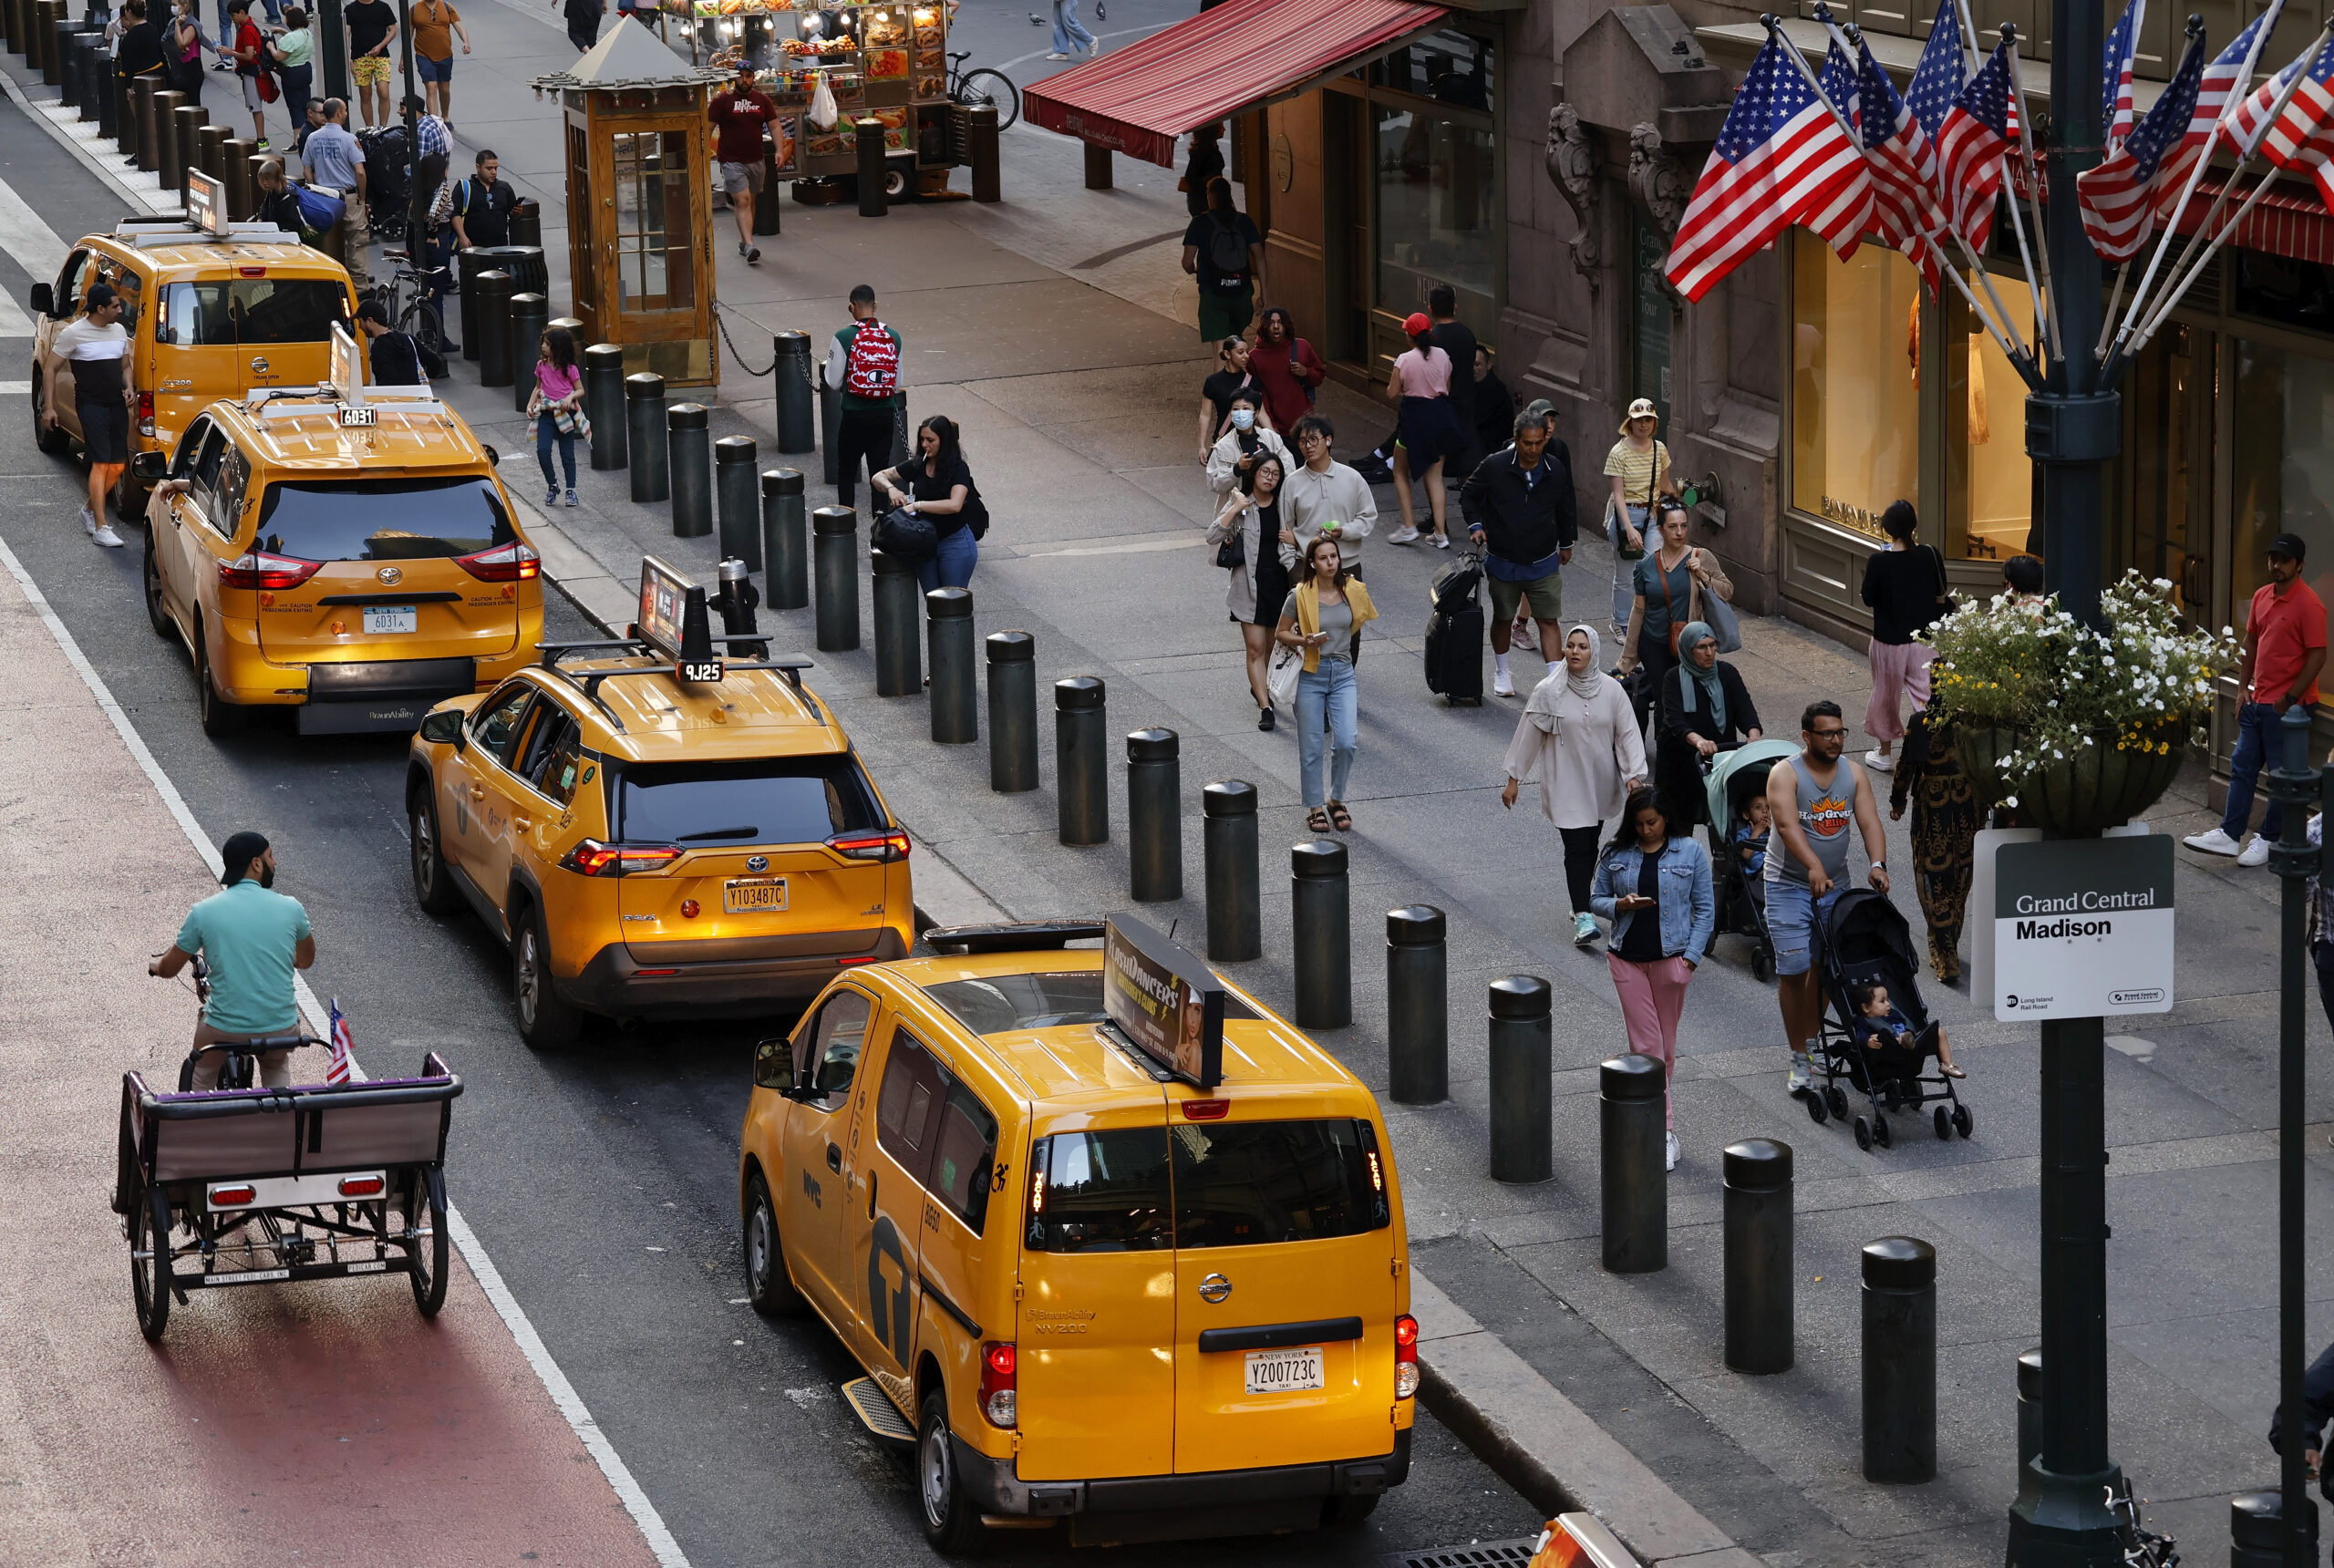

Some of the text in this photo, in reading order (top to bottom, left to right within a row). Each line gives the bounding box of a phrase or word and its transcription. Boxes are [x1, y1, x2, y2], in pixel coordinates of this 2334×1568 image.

[734, 101, 760, 113] Pepper
[315, 146, 340, 160] FIRE
[686, 664, 720, 681] 9J25
[369, 707, 415, 720] BraunAbility
[730, 887, 782, 905] Y103487C
[2016, 887, 2155, 914] Grand Central
[2016, 918, 2112, 940] Madison
[1368, 1152, 1382, 1191] VACANT
[1032, 1172, 1044, 1212] VACANT
[222, 1274, 242, 1283] STREET
[1038, 1309, 1097, 1321] BraunAbility
[1035, 1323, 1088, 1335] NV200
[1265, 1351, 1304, 1361] NEW YORK
[1252, 1358, 1316, 1385] Y200723C
